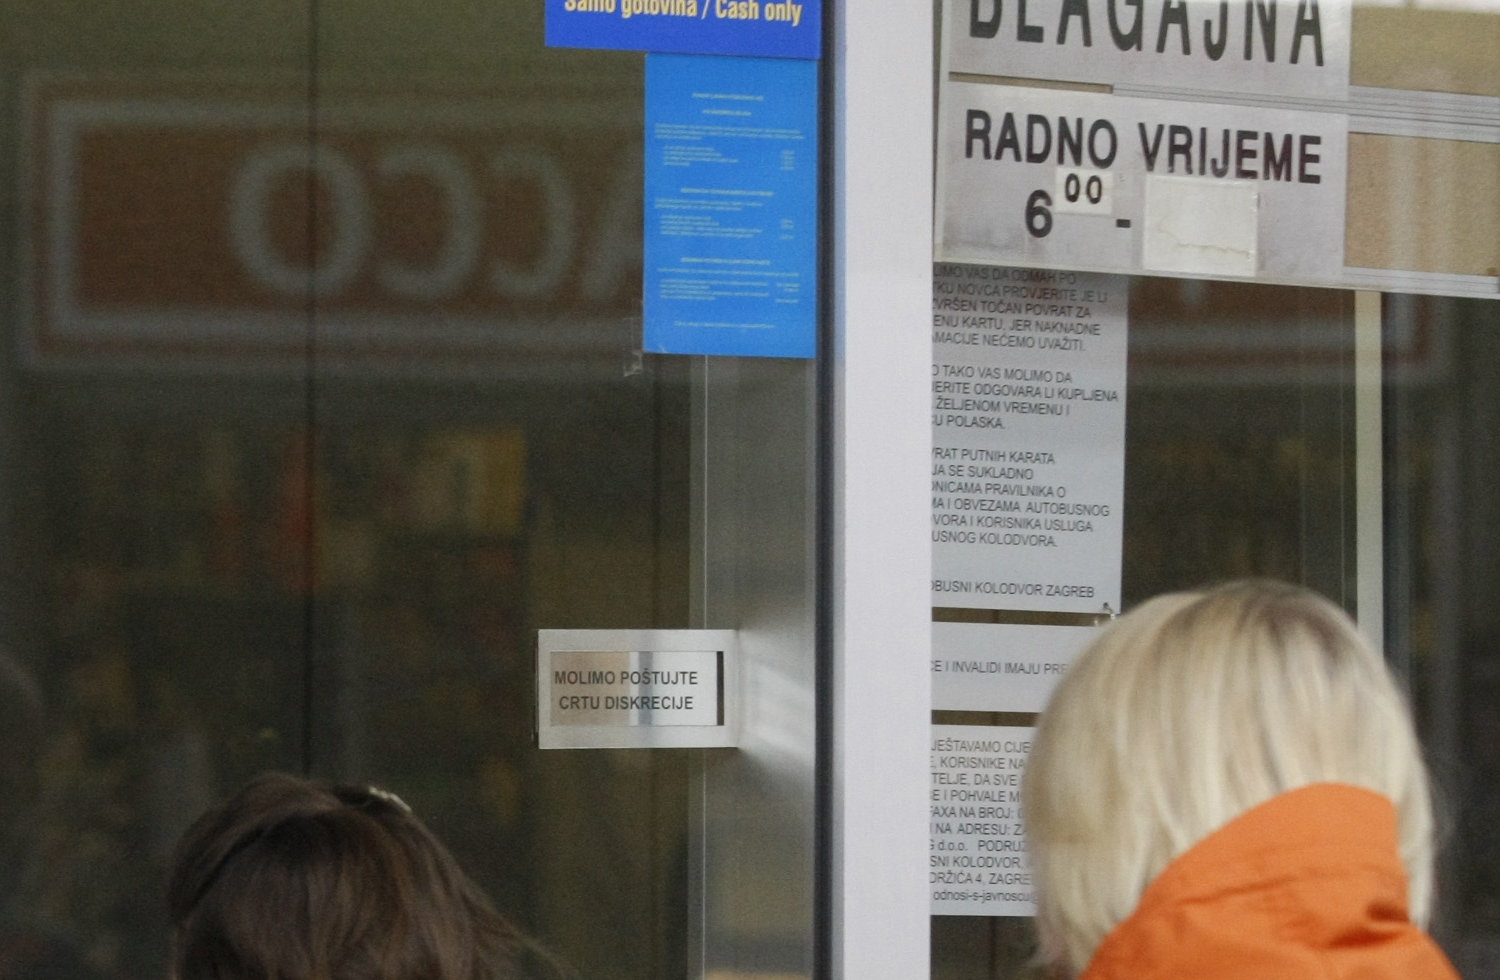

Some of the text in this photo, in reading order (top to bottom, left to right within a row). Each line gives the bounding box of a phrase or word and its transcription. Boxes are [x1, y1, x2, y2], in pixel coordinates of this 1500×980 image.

[621, 0, 698, 18] gotovina
[715, 0, 760, 20] Cash
[765, 0, 803, 27] only
[965, 109, 1323, 184] RADNO VRIJEME
[936, 395, 1000, 414] ŽELJENOM
[1002, 401, 1063, 416] VREMENU
[960, 448, 1055, 465] PUTNIH KARATA
[953, 498, 1021, 514] OBVEZAMA
[1025, 501, 1109, 517] AUTOBUSNOG
[976, 515, 1042, 531] KORISNIKA
[1044, 518, 1093, 533] USLUGA
[974, 581, 1094, 599] KOLODVOR ZAGREB
[554, 667, 698, 686] MOLIMO POŠTUJTE
[951, 660, 1040, 676] INVALIDI IMAJU
[559, 695, 693, 710] CRTU DISKRECIJE
[939, 756, 1005, 770] KORISNIKE
[949, 789, 1006, 803] POHVALE
[956, 823, 1011, 837] ADRESU:
